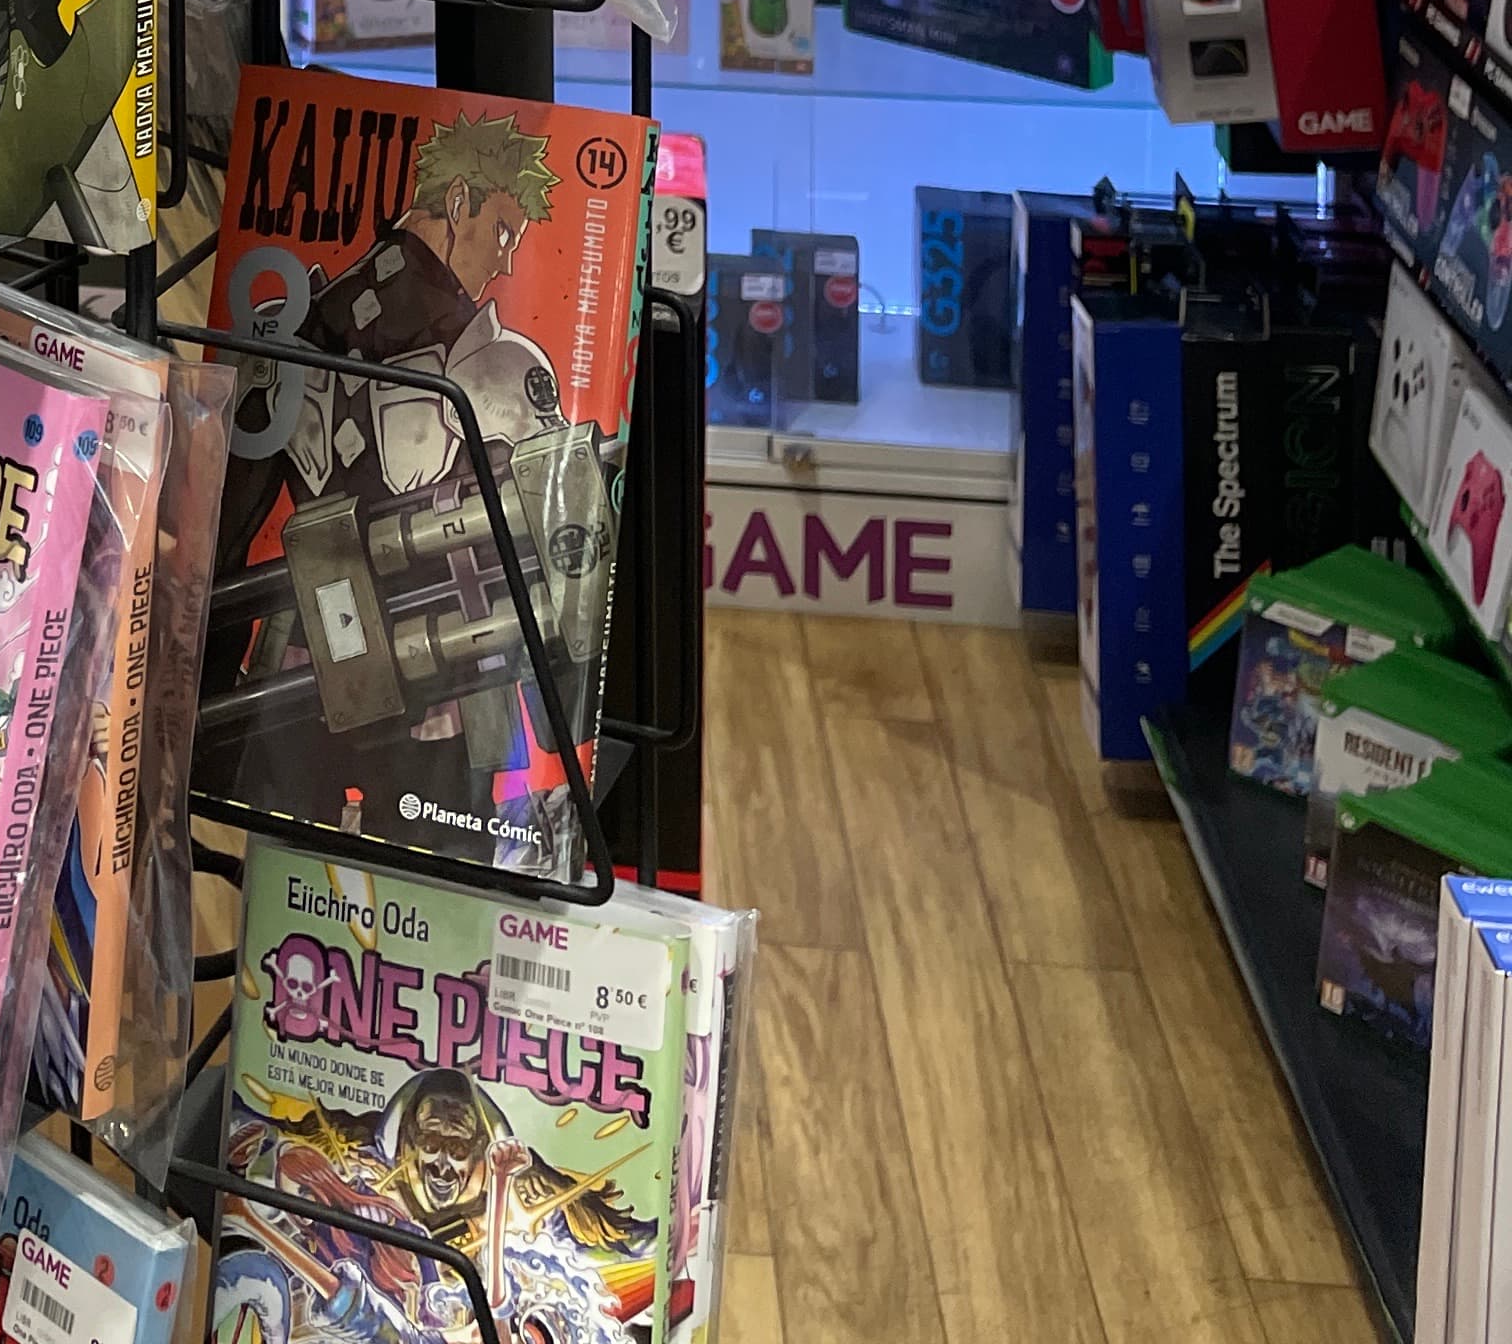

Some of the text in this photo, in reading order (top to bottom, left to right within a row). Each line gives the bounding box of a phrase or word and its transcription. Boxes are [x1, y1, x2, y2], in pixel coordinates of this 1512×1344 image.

[133, 83, 154, 159] NAOYA
[1297, 108, 1373, 136] GAME
[238, 96, 420, 246] KAIJU
[587, 148, 616, 178] 14
[568, 196, 609, 390] NAOYA MATSUMOTO
[34, 332, 85, 372] GAME
[1212, 371, 1246, 580] The Spectrum
[705, 508, 954, 610] AME
[34, 607, 68, 687] PIECE
[24, 689, 52, 741] ONE
[112, 560, 154, 875] EIICHIRO ODA ONE PIECE
[1343, 731, 1415, 776] RESIDENT
[7, 766, 38, 819] ODA
[422, 801, 543, 846] Planeta Cómic
[288, 876, 429, 943] Eiichiro Oda
[500, 914, 569, 951] GAME
[263, 933, 423, 1068] ONE
[269, 1042, 369, 1083] UN MUNDO DONDE
[298, 1070, 387, 1110] MEJOR MUERTO
[21, 1236, 73, 1291] GAME
